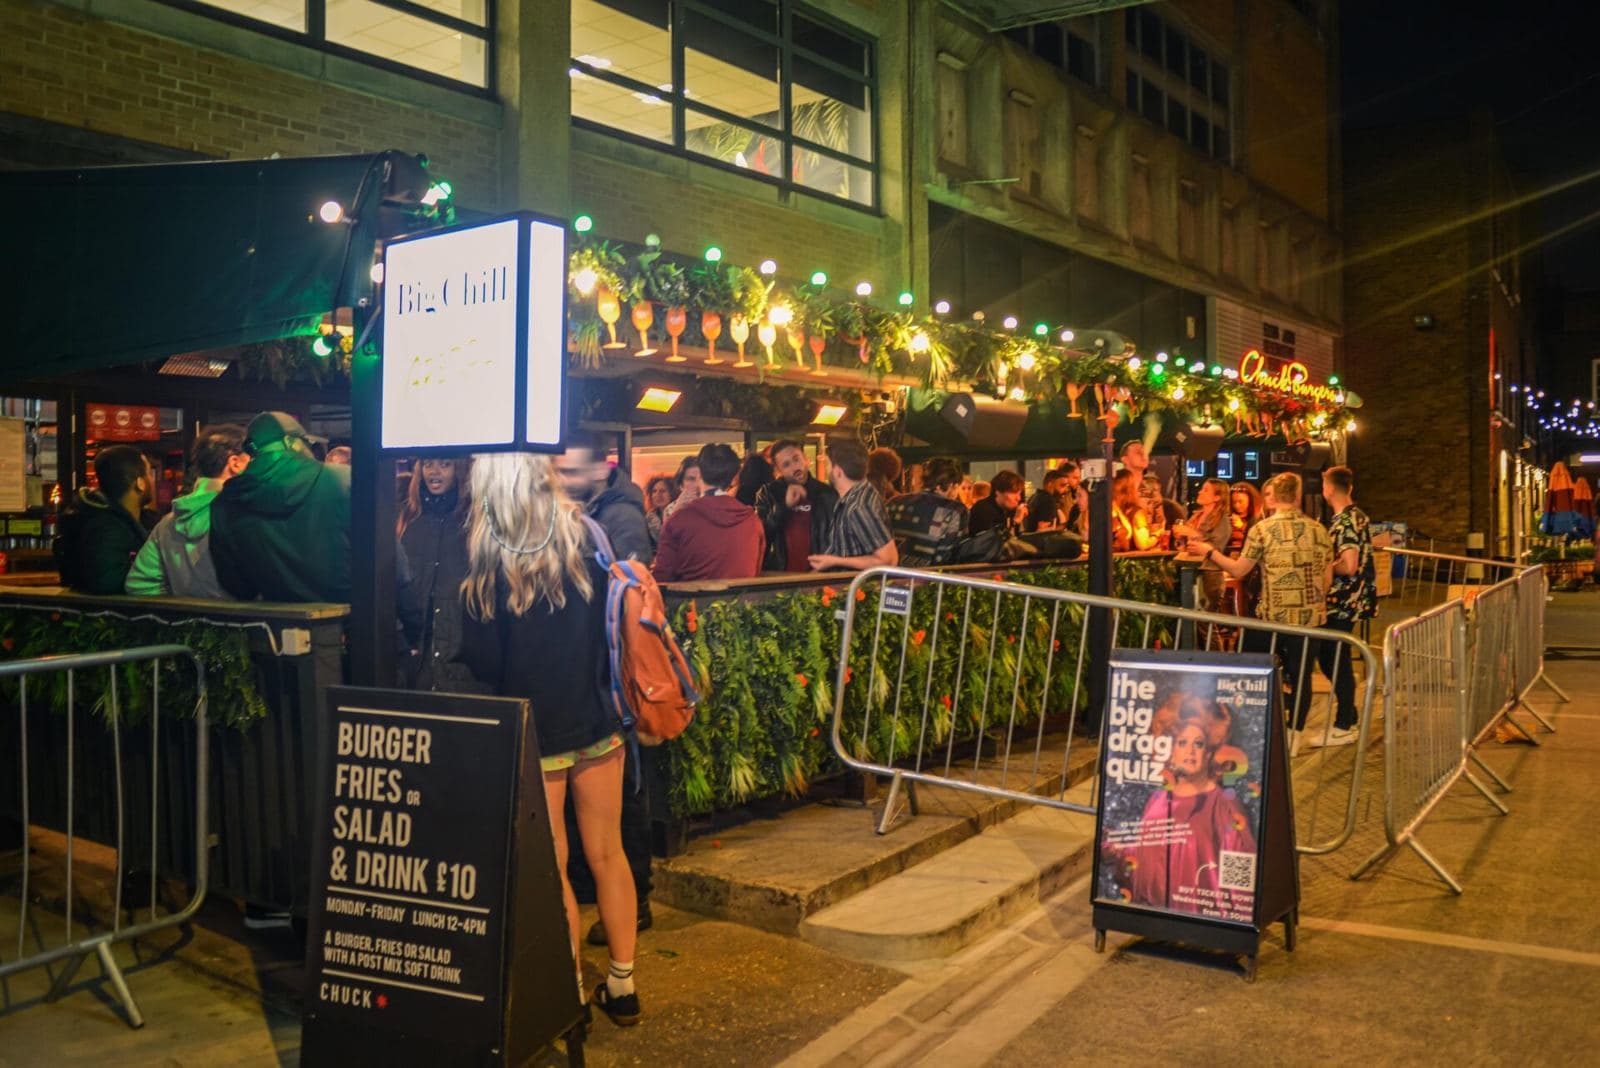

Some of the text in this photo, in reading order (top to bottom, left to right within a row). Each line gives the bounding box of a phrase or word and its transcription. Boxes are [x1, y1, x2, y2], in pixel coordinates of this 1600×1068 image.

[1111, 672, 1156, 700] the
[1110, 698, 1153, 734] big
[338, 721, 431, 764] BURGER
[1108, 726, 1173, 761] drag
[335, 763, 420, 806] FRIES OR
[1106, 754, 1166, 785] quiz
[333, 805, 412, 848] SALAD
[329, 846, 476, 900] & DRINK £10
[1171, 894, 1214, 908] Wednesday
[1178, 886, 1195, 894] BUY
[1196, 888, 1229, 899] TICKETS
[326, 897, 487, 936] MONDAY-FRIDAY LUNCH 12-4PM
[1202, 908, 1221, 917] from
[324, 930, 332, 945] A
[375, 938, 402, 957] FRIES
[404, 943, 417, 956] OR
[419, 945, 451, 964] SALAD
[323, 947, 462, 985] WITH A POST MIX SOFT DRINK
[319, 982, 372, 1009] CHUCK
